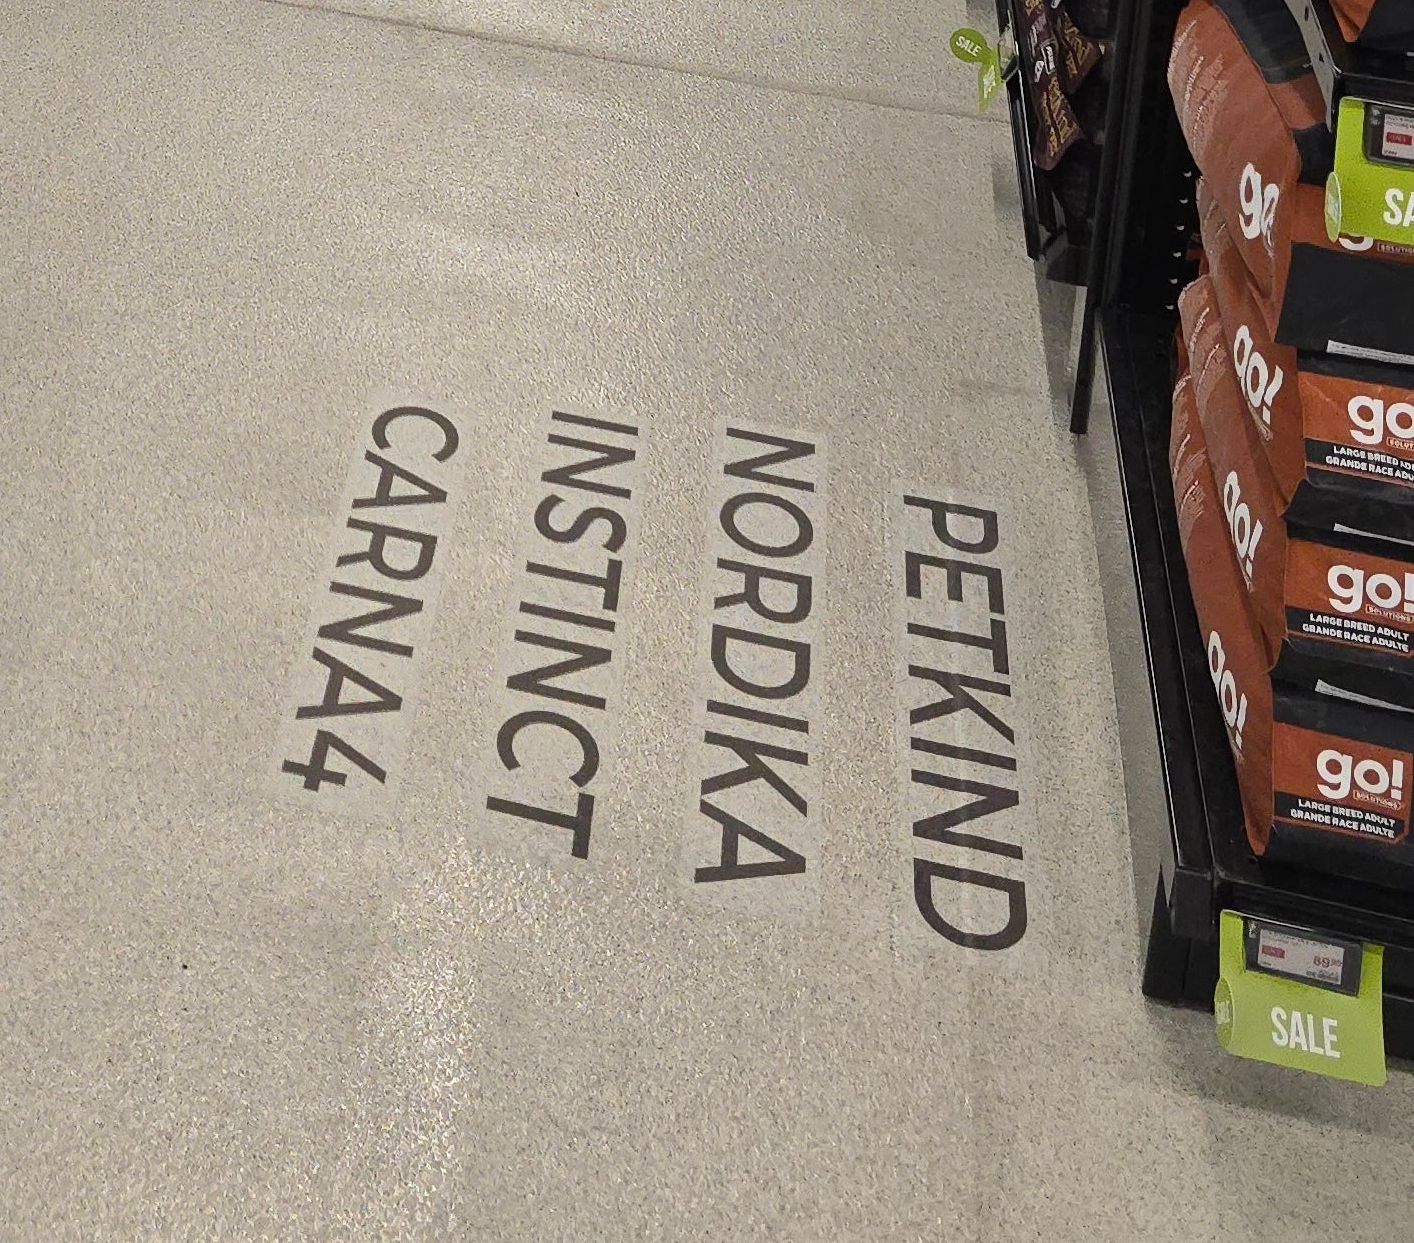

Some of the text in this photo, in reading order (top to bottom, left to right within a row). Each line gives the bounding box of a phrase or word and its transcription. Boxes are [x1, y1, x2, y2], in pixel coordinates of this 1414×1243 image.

[955, 36, 980, 57] SALE
[1234, 324, 1283, 425] go!
[1326, 456, 1393, 476] GRANDE RACE
[1334, 446, 1398, 466] LARGE BREED
[281, 404, 460, 792] CARNA4
[485, 410, 640, 860] INSTINCT
[1302, 623, 1409, 653] GRANDE RACE ADULTE
[1310, 613, 1410, 642] LARGE BREED ADULT
[693, 426, 817, 883] NORDIKA
[902, 494, 1029, 952] PETKIND
[1316, 749, 1404, 801] go!
[1290, 808, 1395, 839] GRANDE RACE ADULTE
[1298, 798, 1395, 827] LARGE BREED ADULT
[1271, 1006, 1341, 1058] SALE
